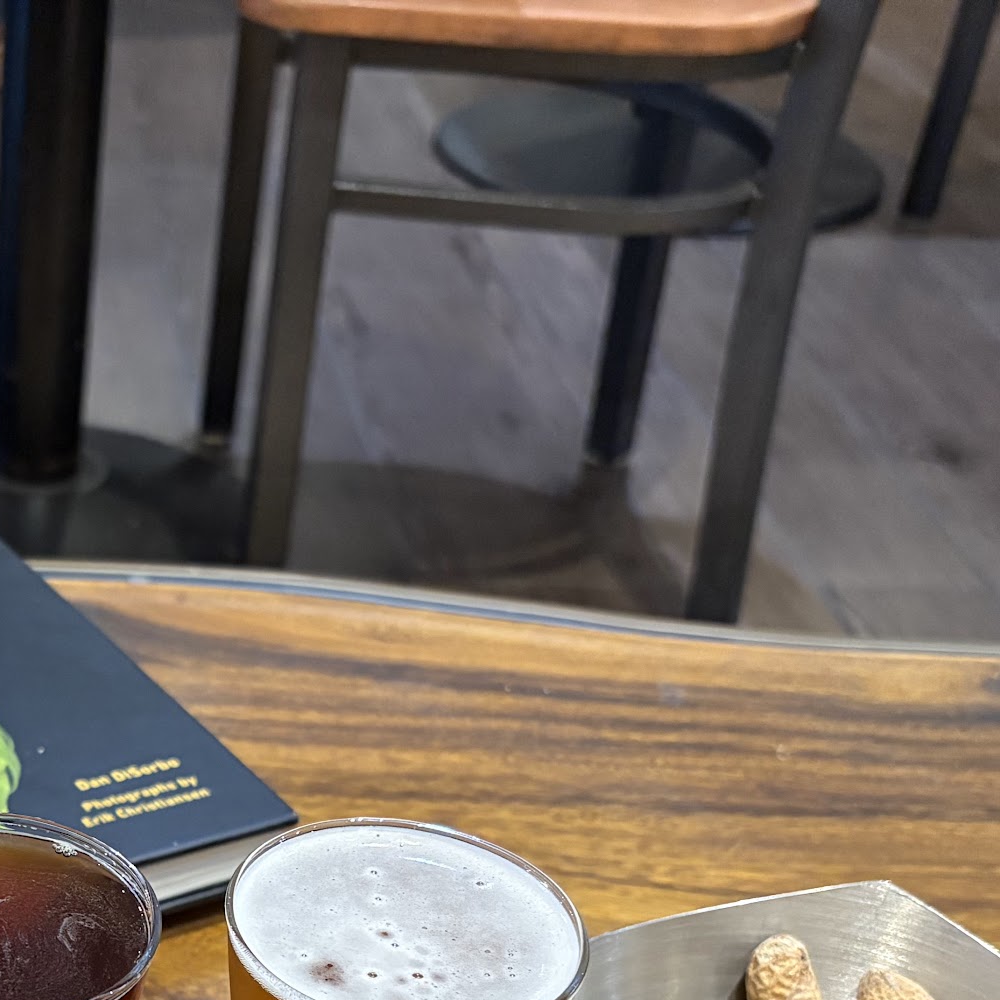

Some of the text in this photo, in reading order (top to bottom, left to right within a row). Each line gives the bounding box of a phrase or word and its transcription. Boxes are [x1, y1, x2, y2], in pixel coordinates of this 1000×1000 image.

[73, 777, 111, 792] Dan
[80, 775, 198, 812] Photographs by
[80, 788, 211, 828] Erik Christiansen
